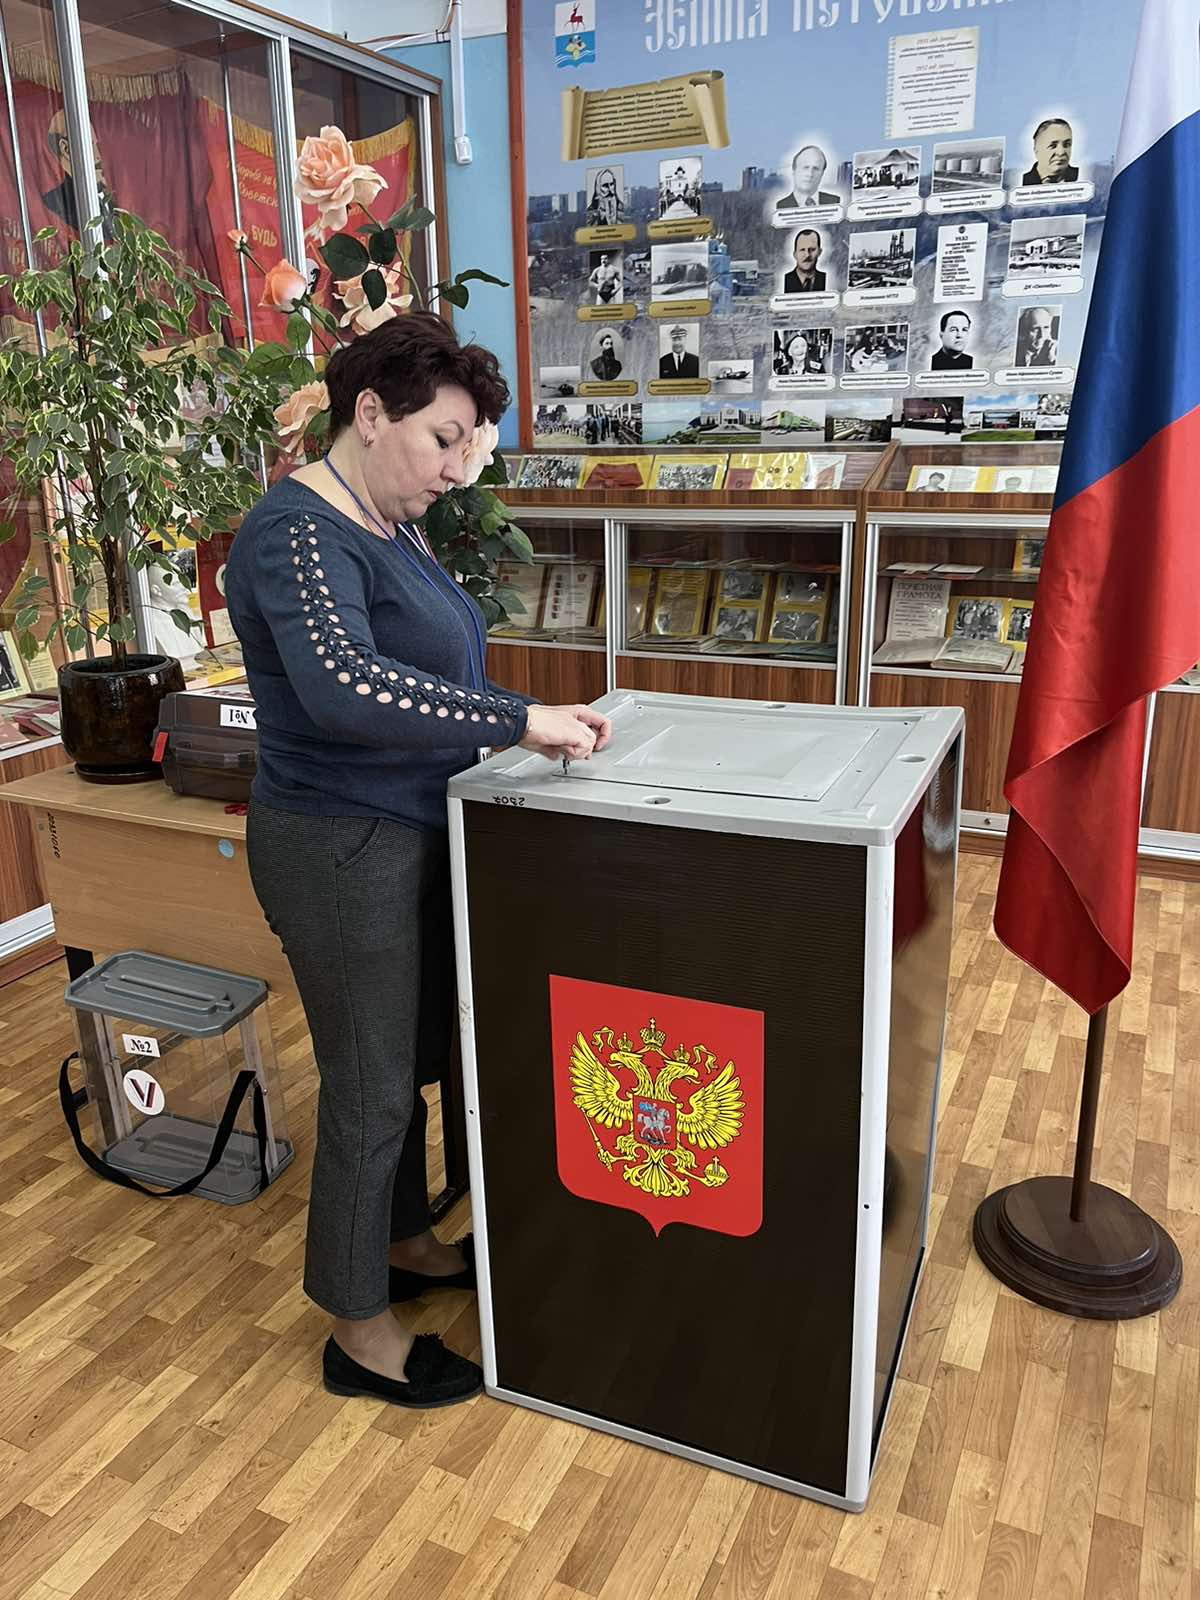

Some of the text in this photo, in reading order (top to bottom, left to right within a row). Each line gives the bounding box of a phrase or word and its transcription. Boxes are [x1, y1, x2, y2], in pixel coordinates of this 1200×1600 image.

[250, 224, 278, 248] БУДЬ
[896, 591, 943, 600] ГРАМОТА
[229, 708, 250, 725] №1
[130, 1038, 153, 1054] №2
